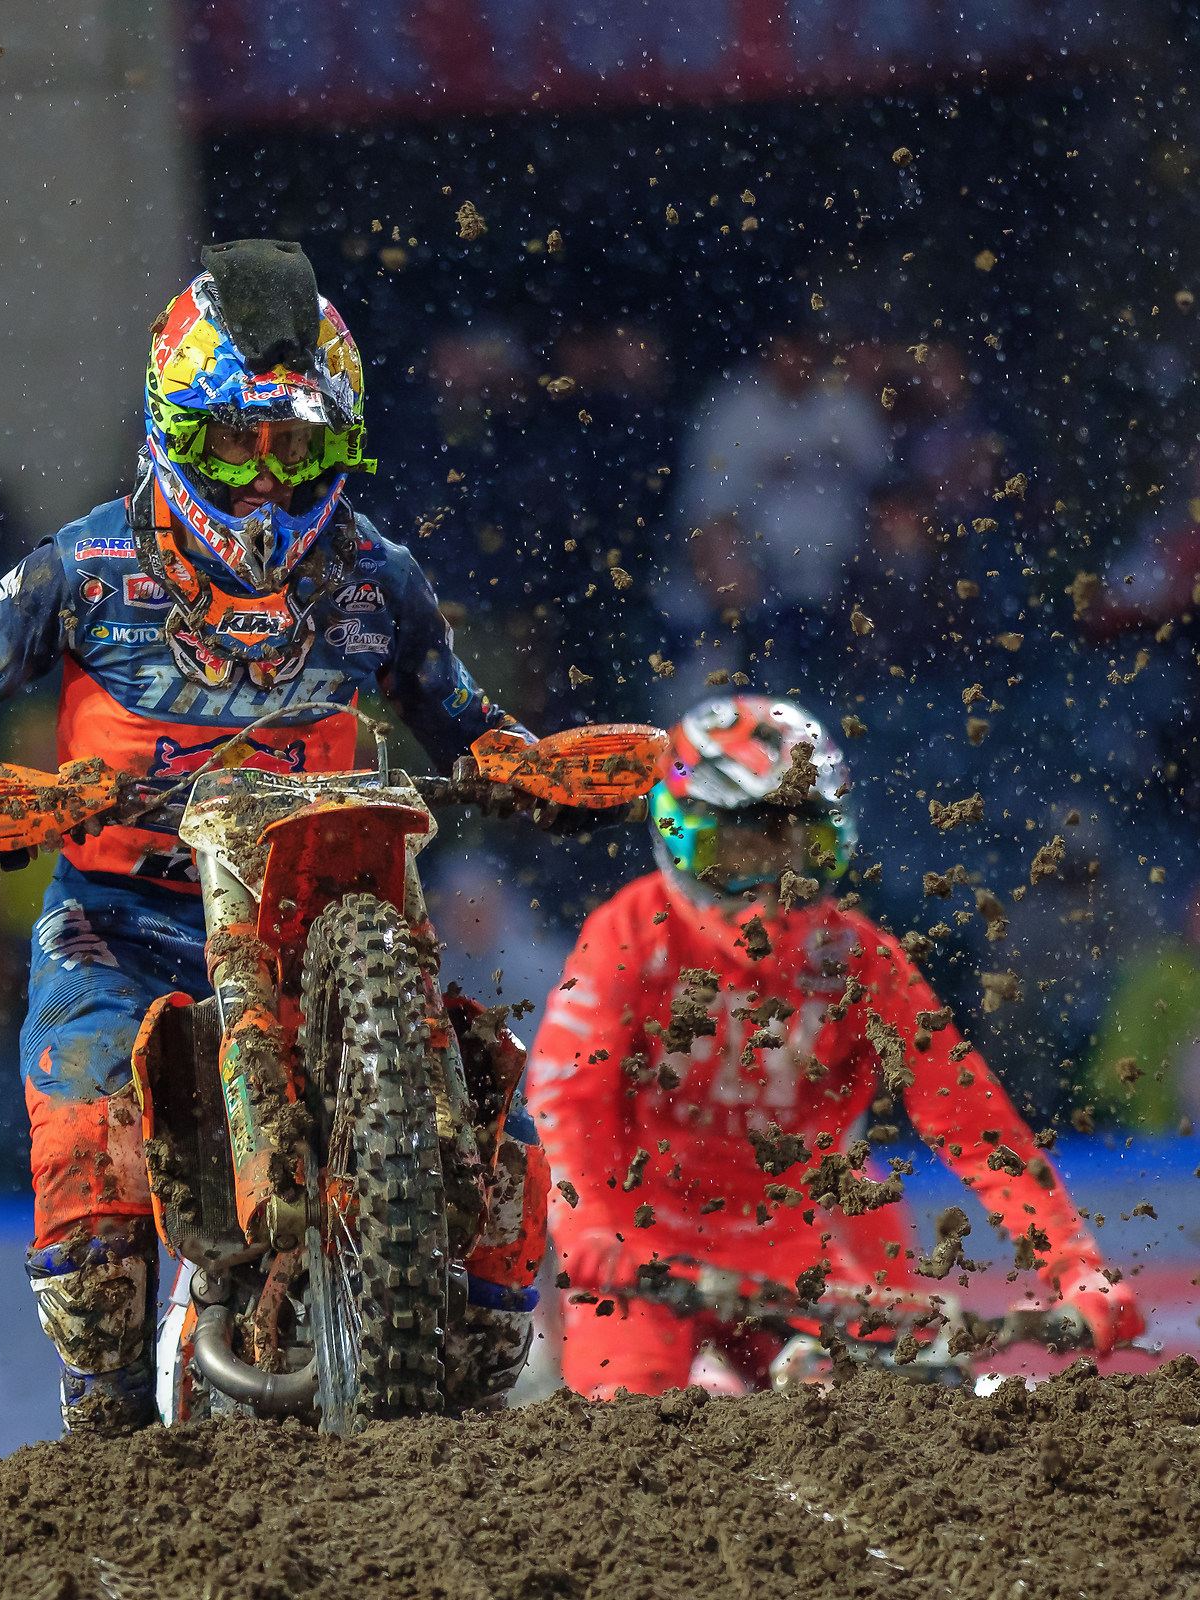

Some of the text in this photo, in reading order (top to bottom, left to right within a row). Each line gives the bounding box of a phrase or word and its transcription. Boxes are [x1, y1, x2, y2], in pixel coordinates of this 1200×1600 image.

[197, 376, 217, 399] Airoh
[242, 383, 286, 404] Red
[75, 537, 134, 552] PART
[132, 580, 171, 600] 100
[335, 584, 385, 605] Airoh
[216, 611, 280, 636] KTM
[112, 626, 165, 643] MOTO
[135, 664, 345, 717] THOR
